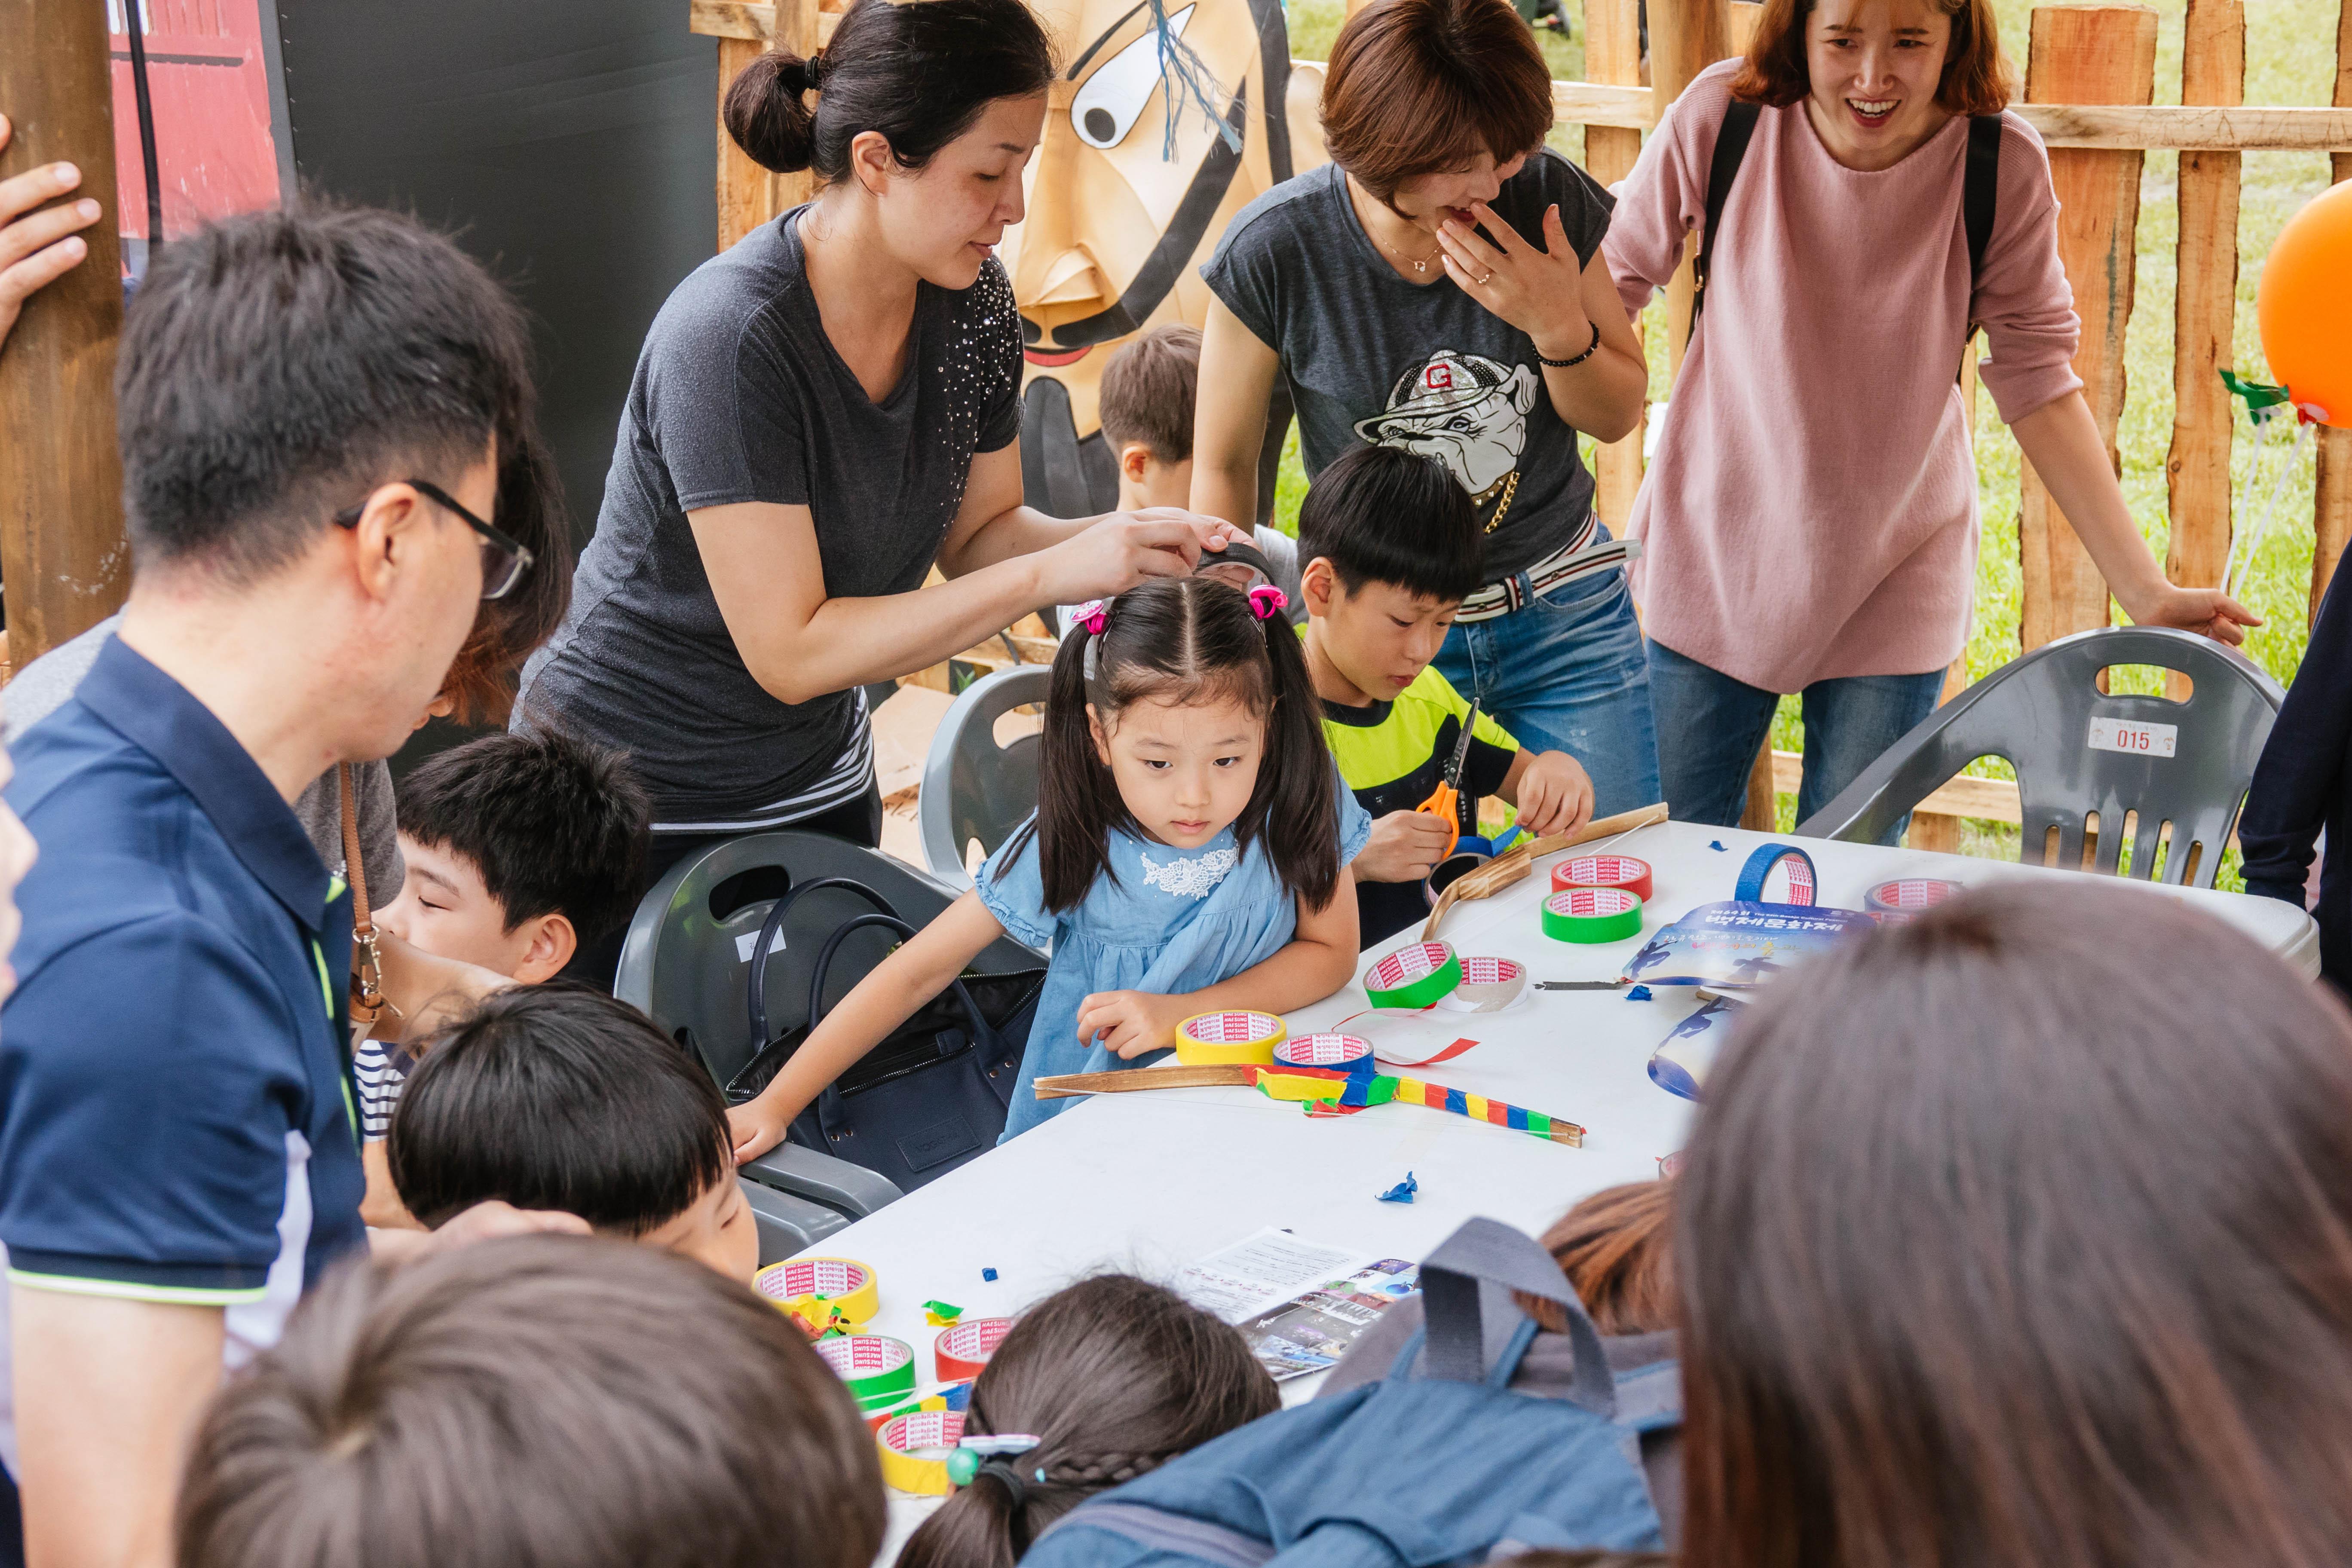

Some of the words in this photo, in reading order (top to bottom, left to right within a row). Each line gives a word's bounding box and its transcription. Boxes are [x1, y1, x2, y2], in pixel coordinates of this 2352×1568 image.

[1426, 364, 1452, 389] G
[2117, 730, 2149, 750] 015
[1705, 915, 1844, 931] 백제문화제
[1379, 958, 1397, 971] HAESUNG
[1381, 963, 1399, 976] HAESUNG
[1383, 968, 1401, 981] HAESUNG
[1385, 973, 1403, 985] HAESUNG
[1292, 1052, 1312, 1060] HAESUNG
[787, 1267, 812, 1275] HAESUNG
[787, 1273, 812, 1281] HAESUNG
[788, 1280, 813, 1288] HAESUNG
[788, 1286, 813, 1294] HAESUNG
